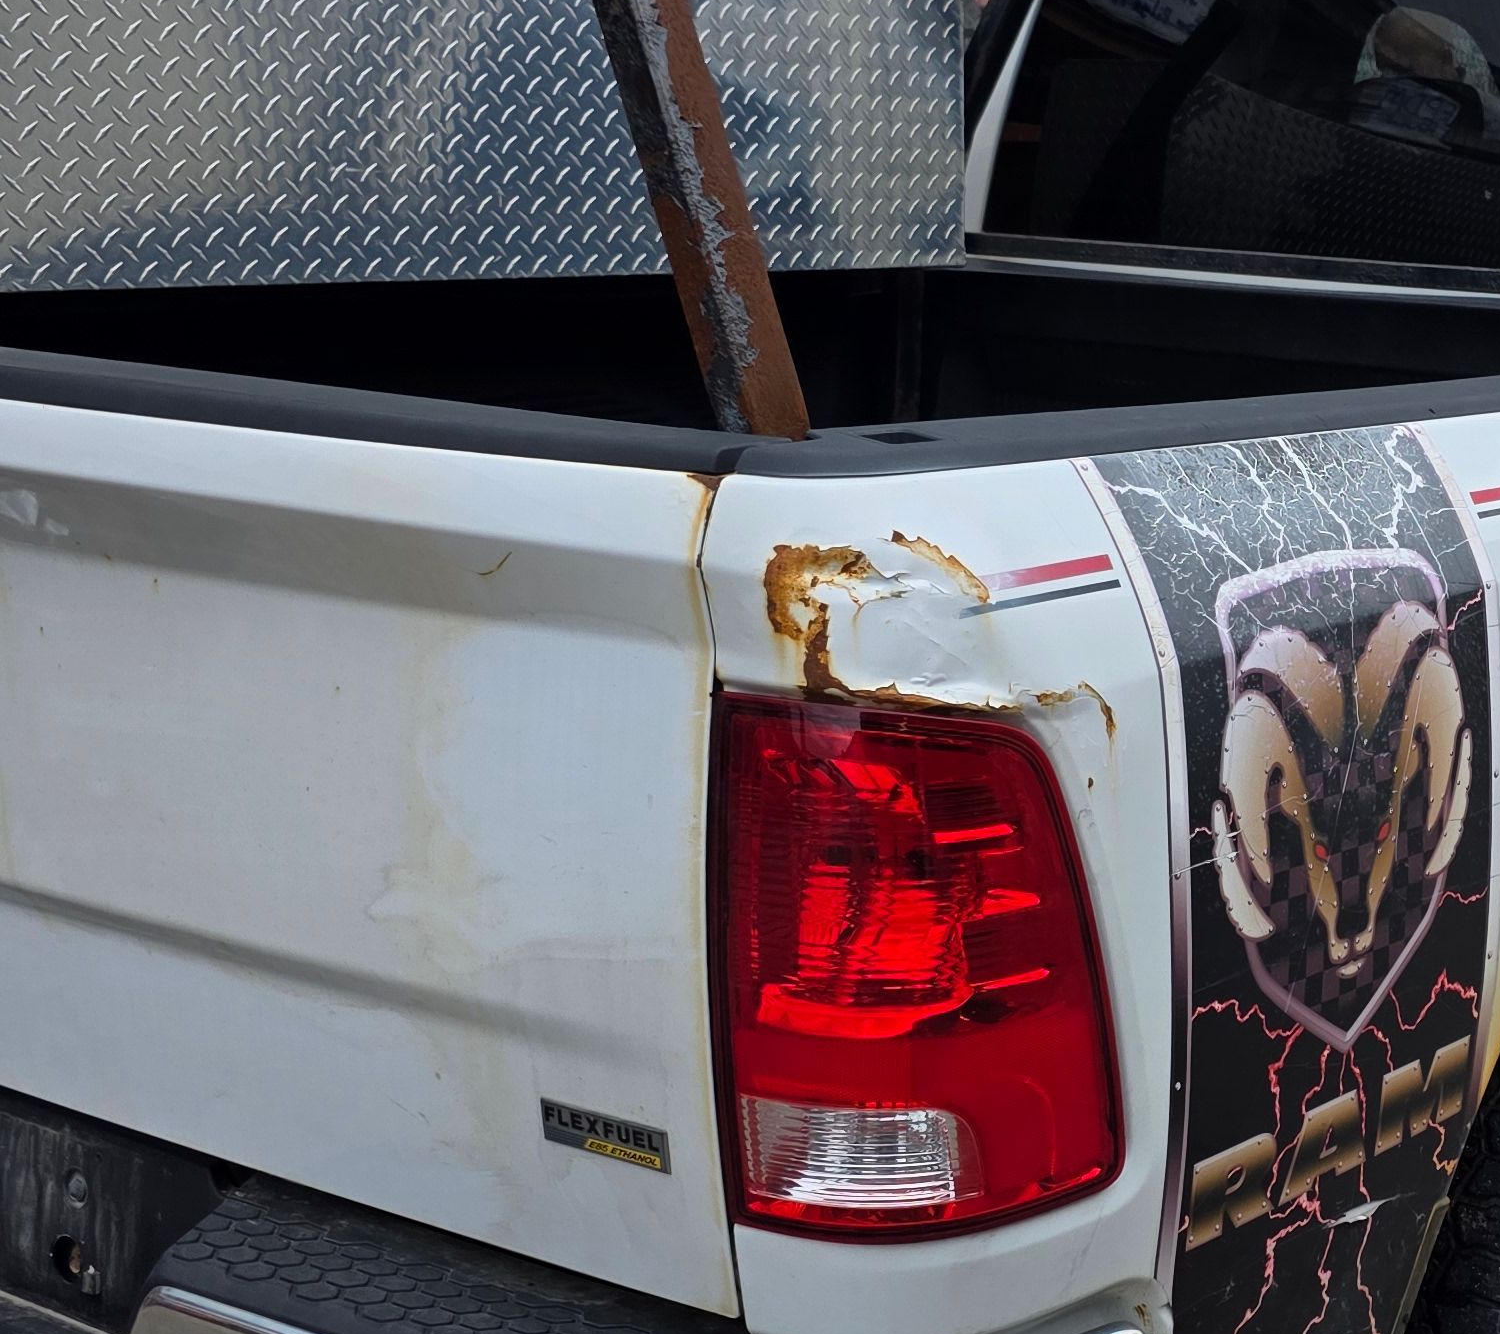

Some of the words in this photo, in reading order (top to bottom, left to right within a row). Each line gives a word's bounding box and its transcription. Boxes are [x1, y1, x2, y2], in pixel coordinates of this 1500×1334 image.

[545, 1106, 659, 1152] FLEXFUEL
[1184, 1033, 1472, 1253] RAM
[588, 1141, 608, 1153] E85
[610, 1147, 657, 1166] ETHANOL
